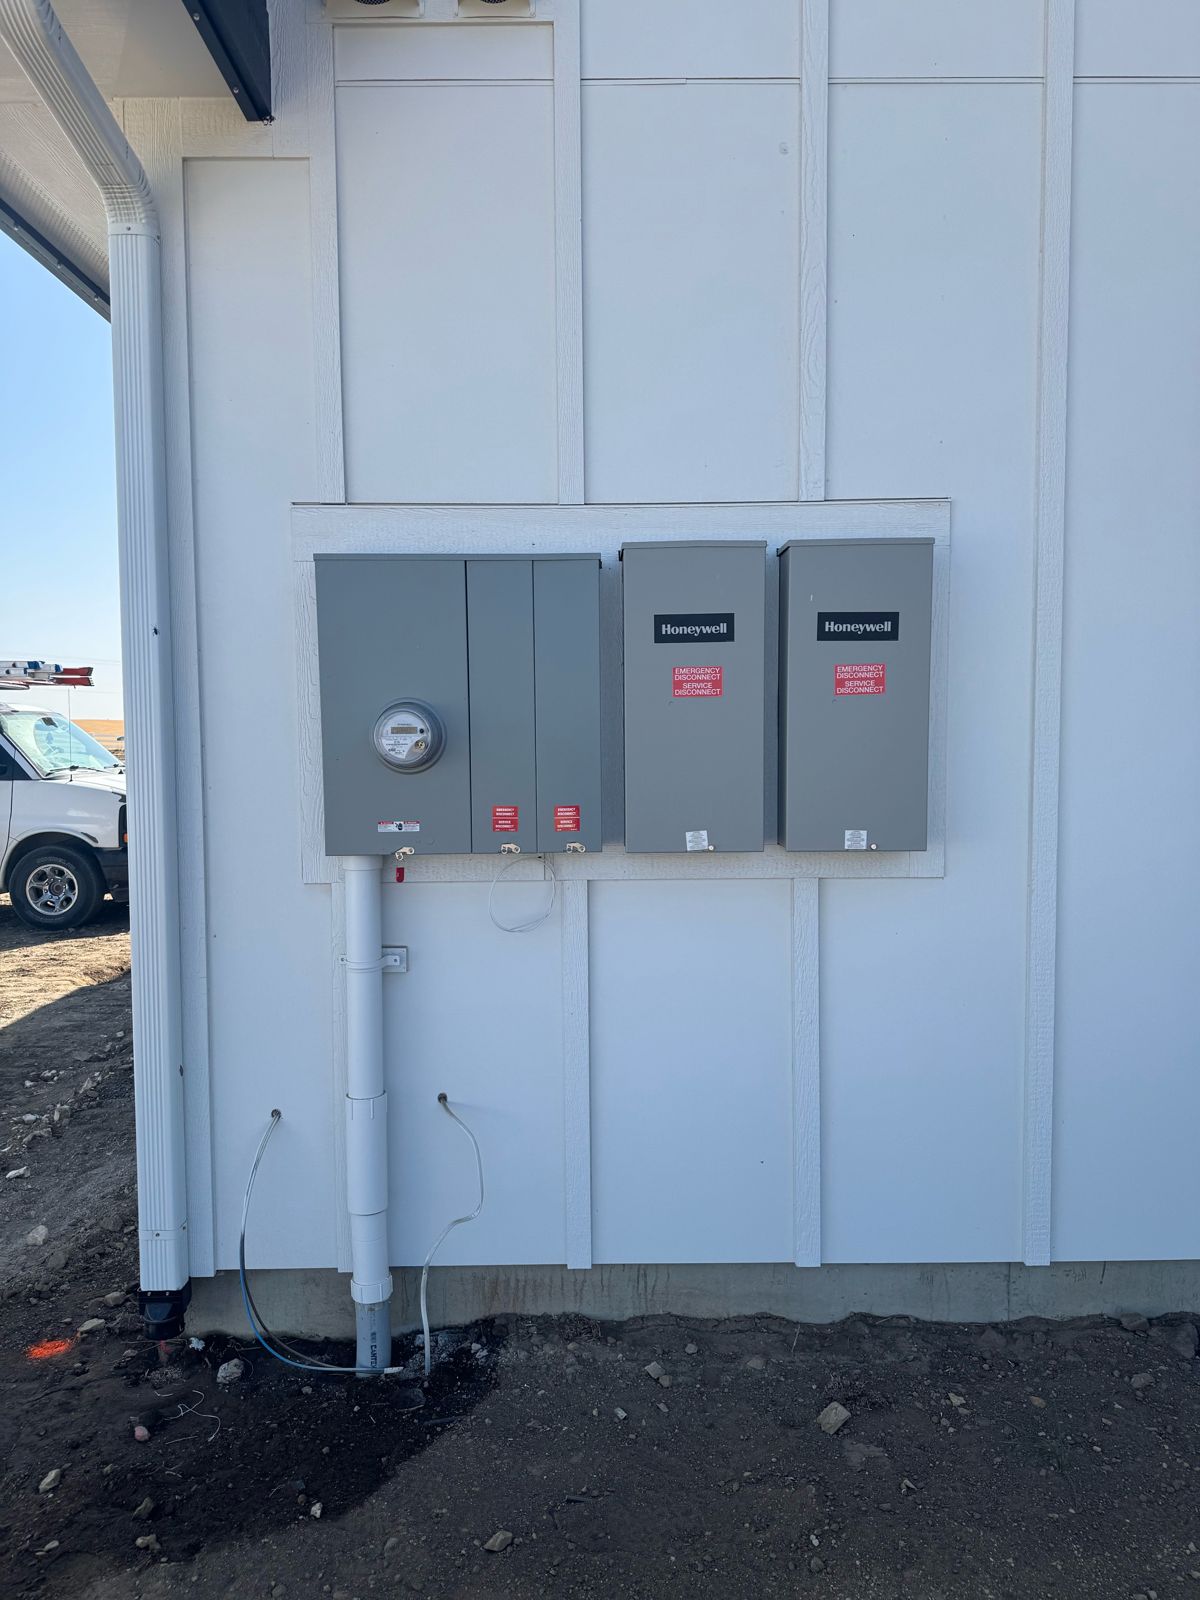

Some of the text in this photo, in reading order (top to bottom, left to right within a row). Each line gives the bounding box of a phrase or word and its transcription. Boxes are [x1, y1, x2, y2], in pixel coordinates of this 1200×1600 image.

[661, 623, 727, 636] Honeywell
[825, 621, 891, 634] Honeywell
[836, 671, 883, 679] DISCONNECT
[836, 686, 883, 694] DISCONNECT
